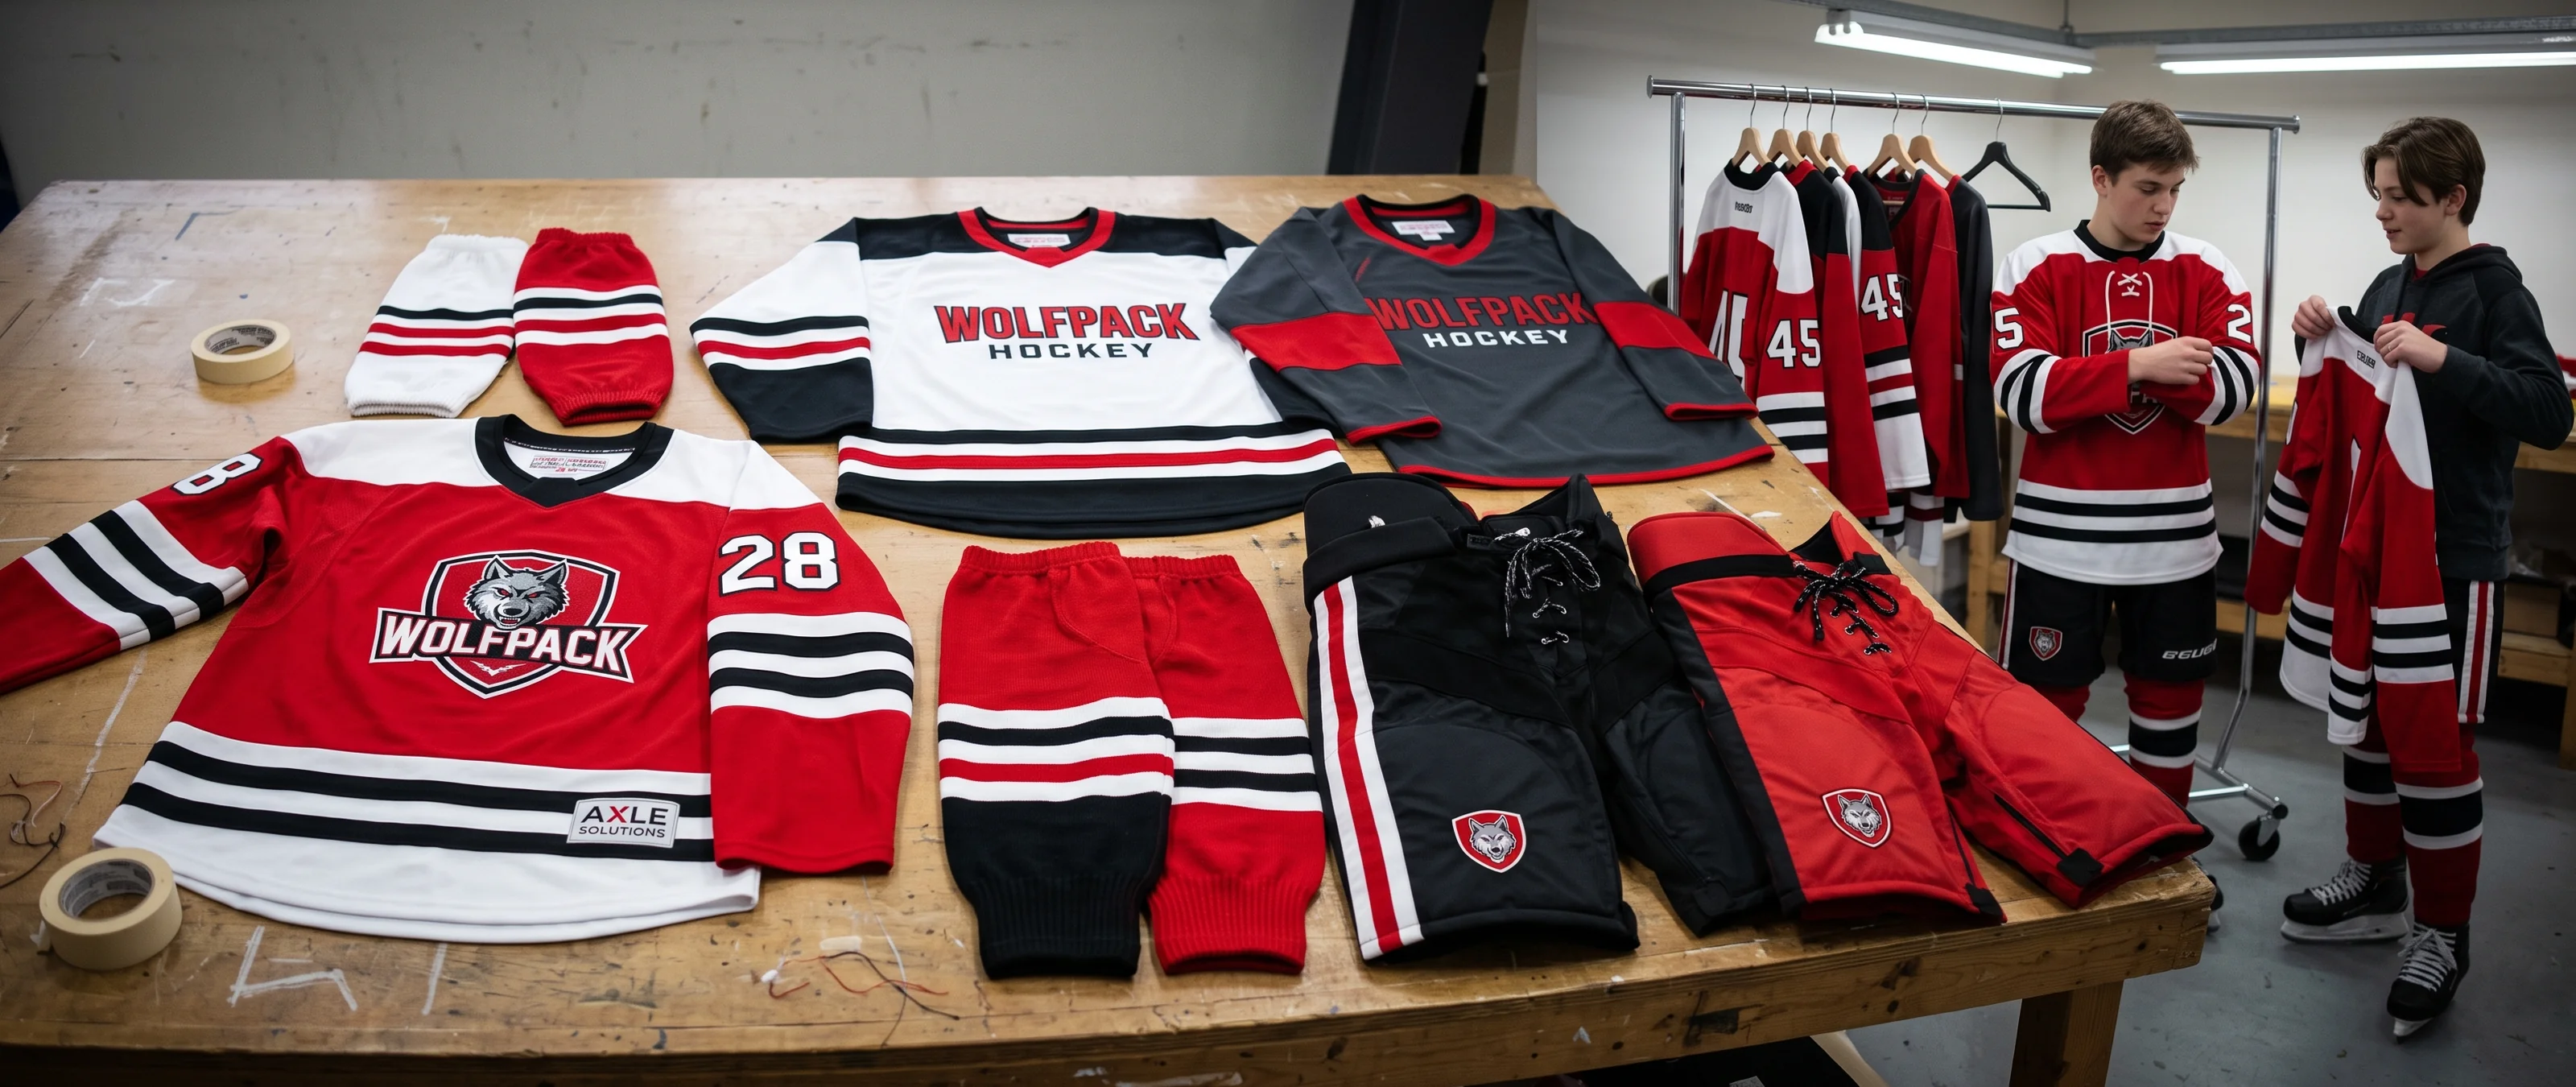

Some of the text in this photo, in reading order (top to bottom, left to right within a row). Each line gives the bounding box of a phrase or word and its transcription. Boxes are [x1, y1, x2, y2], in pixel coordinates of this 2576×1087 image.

[1364, 291, 1600, 331] WOLFPACK
[1860, 272, 1903, 321] 45
[934, 303, 1200, 343] WOLFPACK
[1422, 329, 1568, 348] HOCKEY
[1766, 318, 1822, 368] 45
[1993, 306, 2024, 350] 5
[2226, 303, 2252, 344] 2
[989, 343, 1152, 359] HOCKEY
[170, 452, 264, 496] 8
[719, 531, 840, 597] 28
[379, 614, 632, 675] WOLFPACK
[579, 826, 666, 838] SOLUTIONS
[580, 805, 669, 826] AXLE
